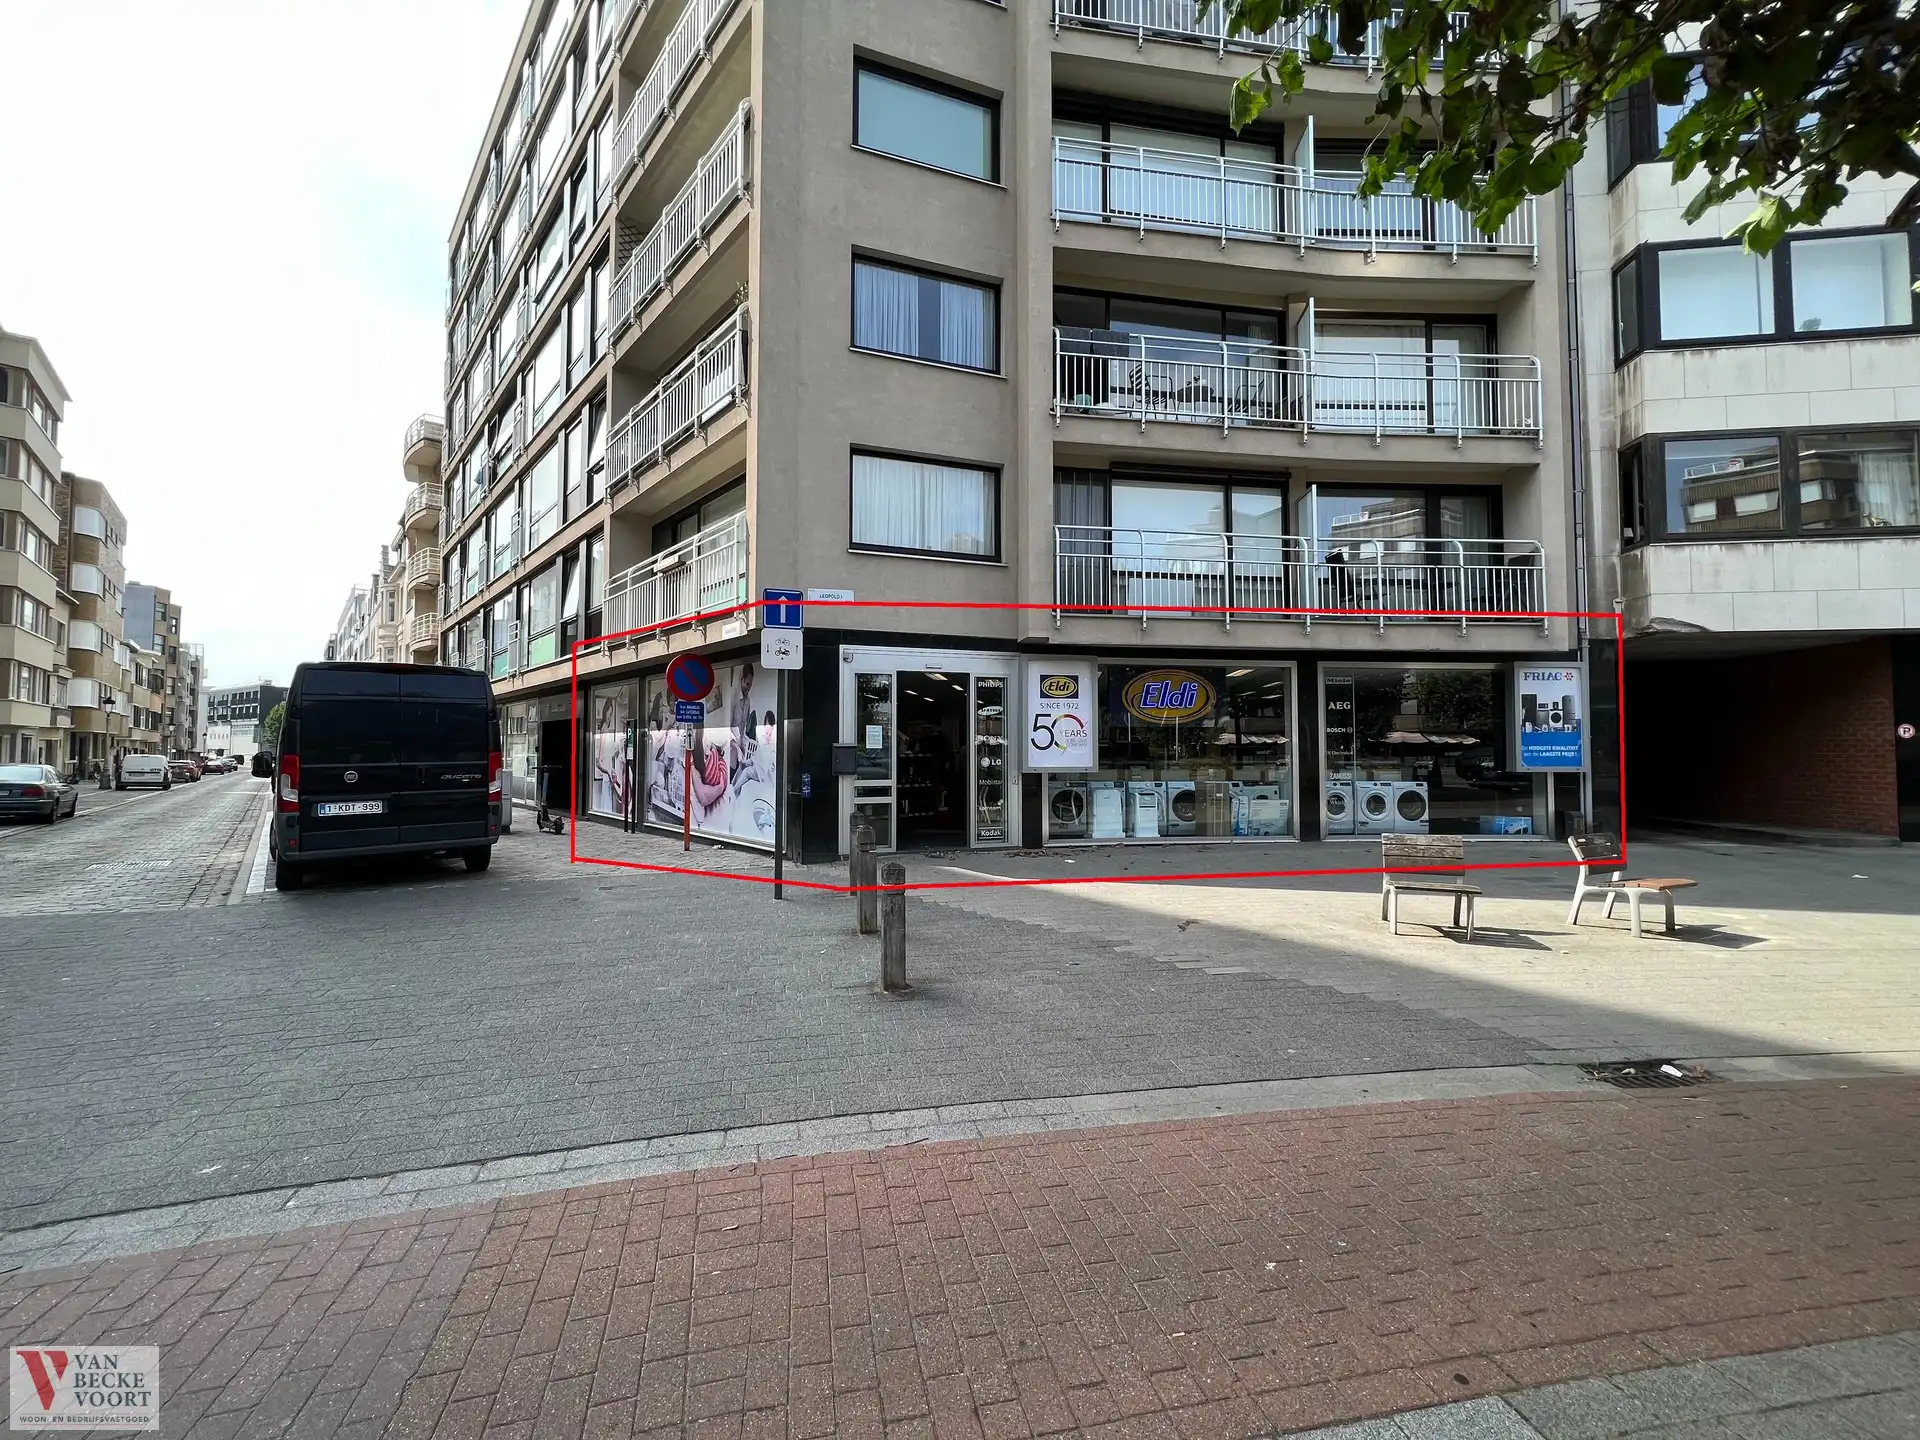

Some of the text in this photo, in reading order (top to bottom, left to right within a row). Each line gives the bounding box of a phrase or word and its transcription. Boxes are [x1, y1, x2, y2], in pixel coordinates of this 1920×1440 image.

[1523, 671, 1563, 681] FRIAC
[1047, 680, 1071, 692] Eldi
[1140, 680, 1198, 709] Eldi
[1063, 702, 1079, 710] 1972
[1328, 701, 1351, 710] AEG
[1031, 713, 1085, 751] 50
[1060, 729, 1088, 738] YEARS
[991, 758, 1002, 766] LG
[326, 802, 380, 814] 1-KDT-999
[981, 829, 1002, 837] Kodak
